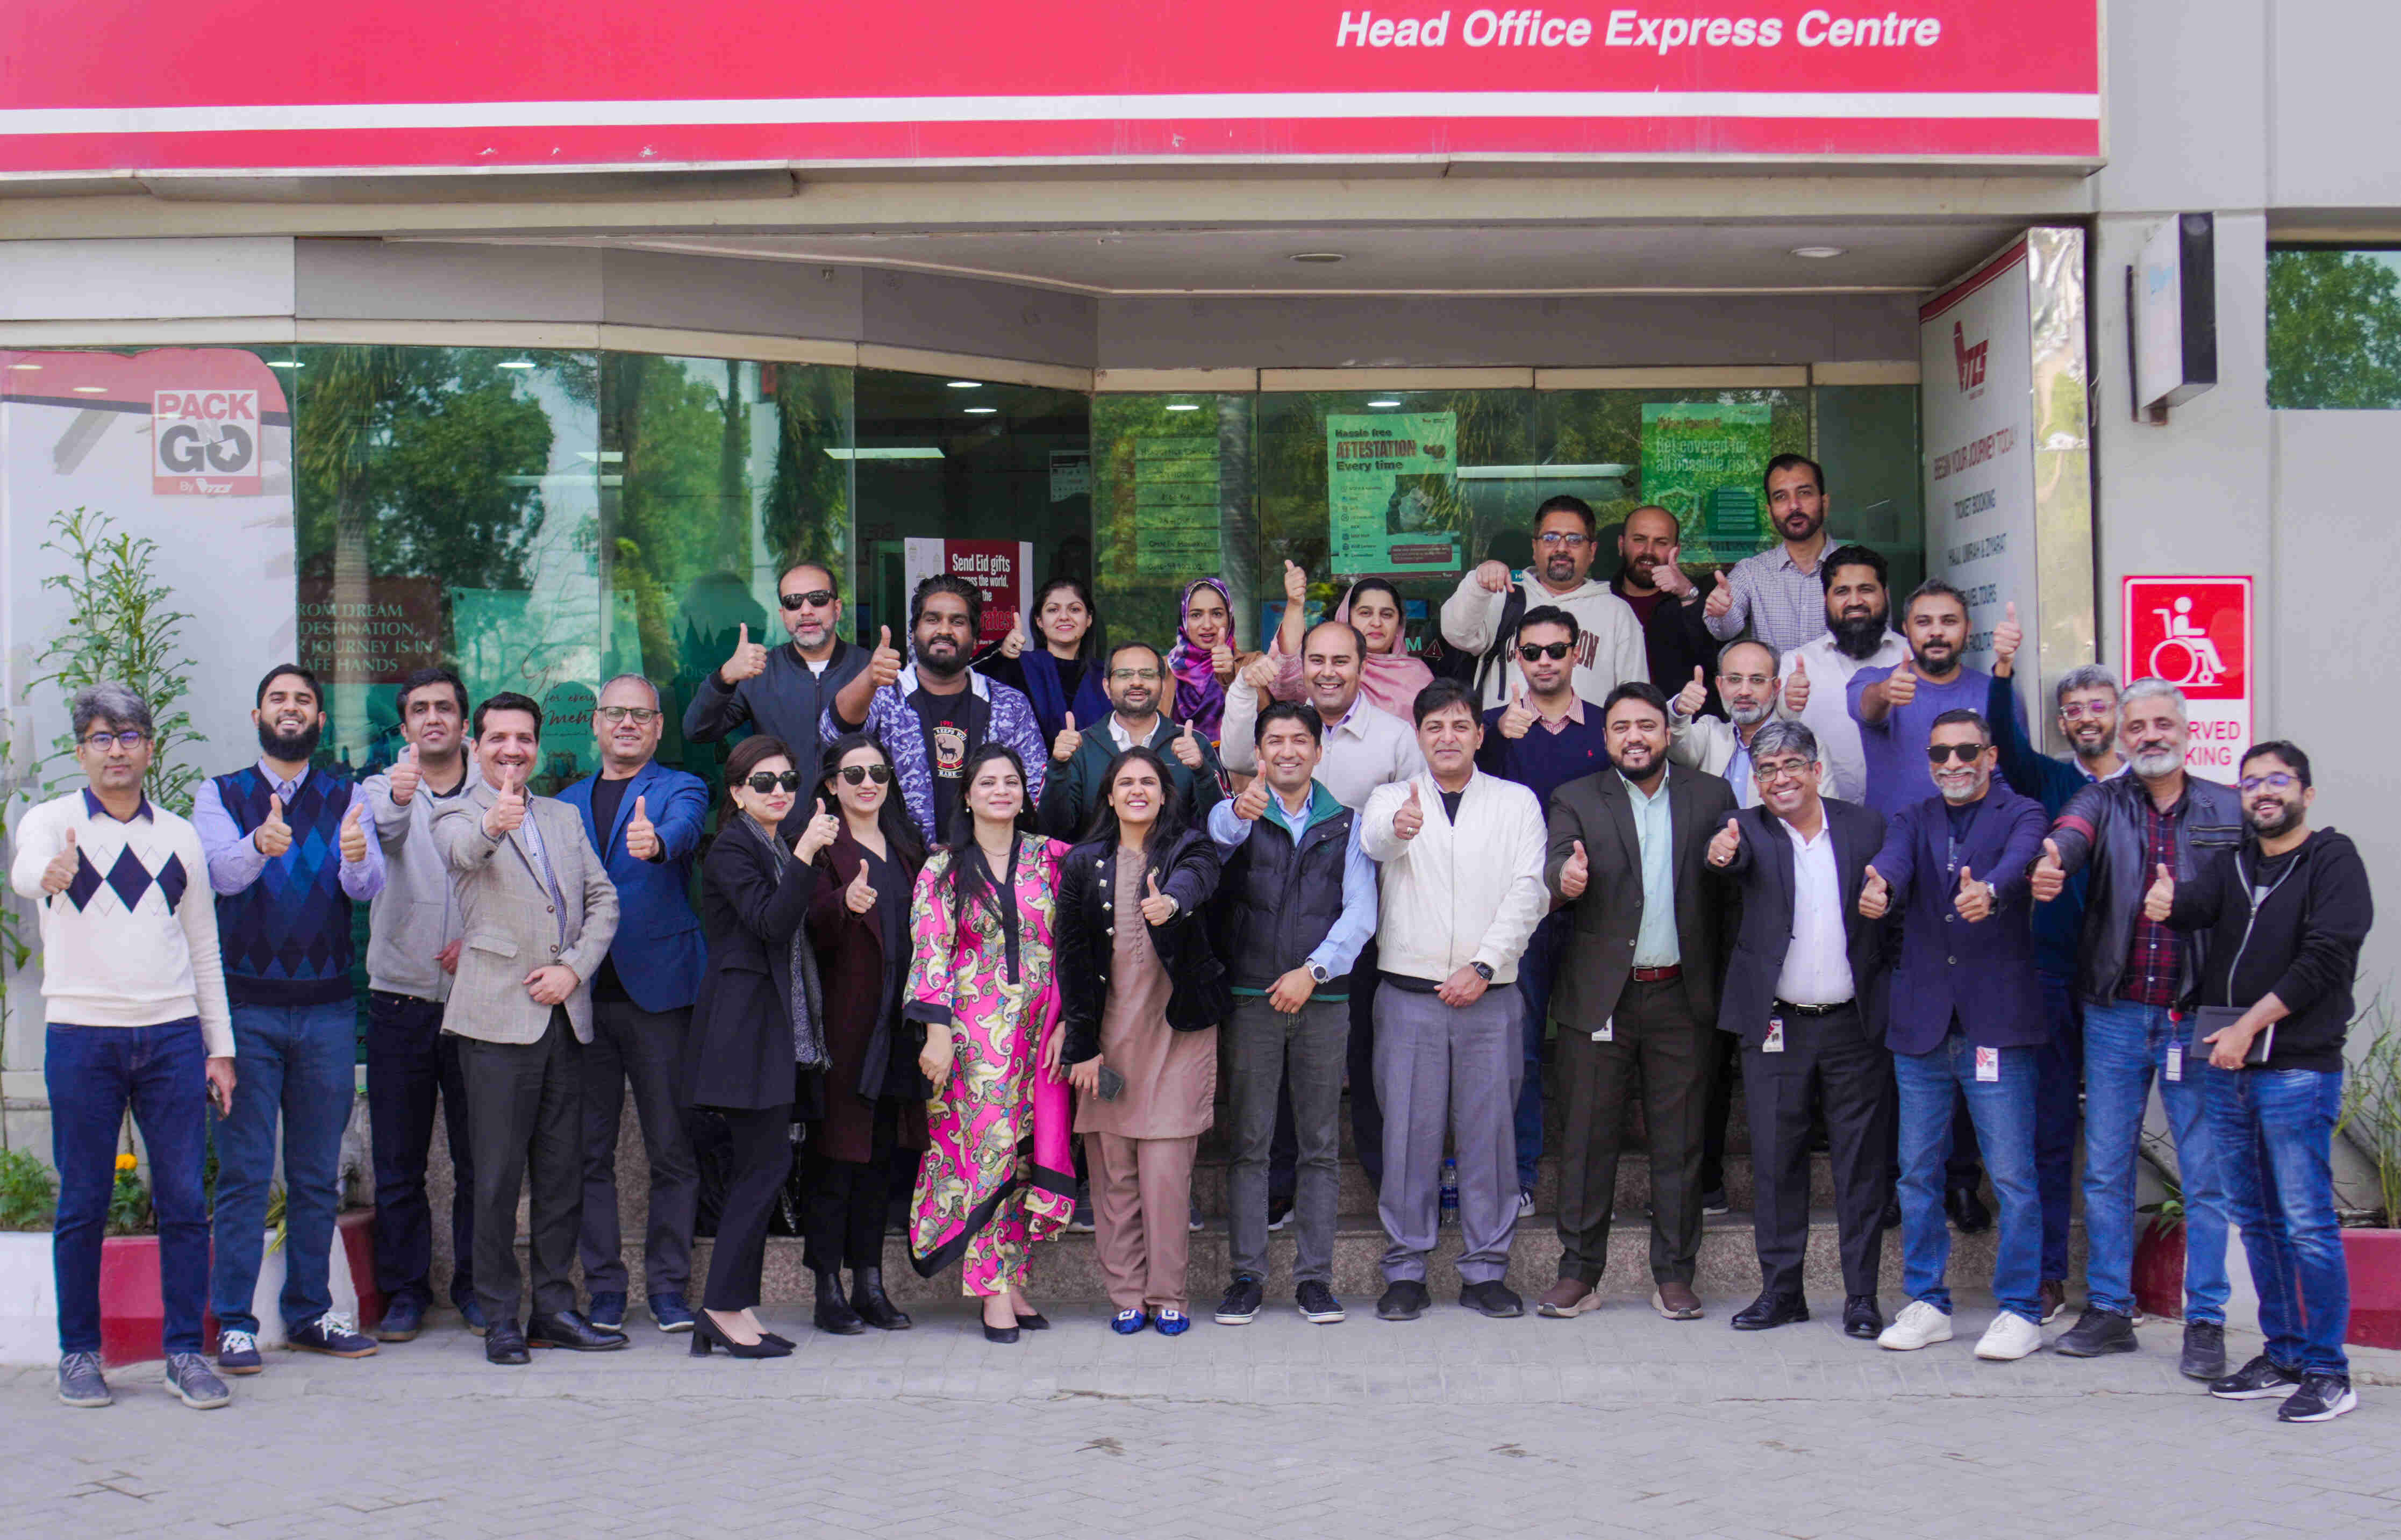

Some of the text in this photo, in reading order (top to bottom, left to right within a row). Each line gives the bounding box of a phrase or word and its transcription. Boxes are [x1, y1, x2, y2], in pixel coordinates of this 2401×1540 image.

[1335, 9, 1941, 55] Head Office Express Centre
[159, 393, 255, 420] PACK
[1335, 428, 1392, 438] Hassle free
[160, 424, 253, 473] GO
[1335, 439, 1417, 459] ATTESTATION
[1681, 438, 1728, 454] covered
[1732, 438, 1748, 454] for
[1335, 460, 1404, 472] Every time
[1656, 455, 1671, 472] all
[1674, 455, 1725, 473] possible
[952, 553, 1010, 575] Send Eid gifts
[978, 575, 989, 587] the
[990, 575, 1009, 588] world,
[982, 589, 992, 601] the
[298, 603, 403, 617] ROM DREAM
[980, 606, 1016, 631] rates!
[300, 621, 419, 636] DESTINATION,
[312, 640, 389, 654] JOURNEY
[395, 640, 410, 653] IS
[415, 640, 434, 654] IN
[304, 658, 399, 671] AFE HANDS
[541, 708, 598, 726] oment
[2186, 720, 2241, 740] RVED
[2184, 746, 2233, 766] KING
